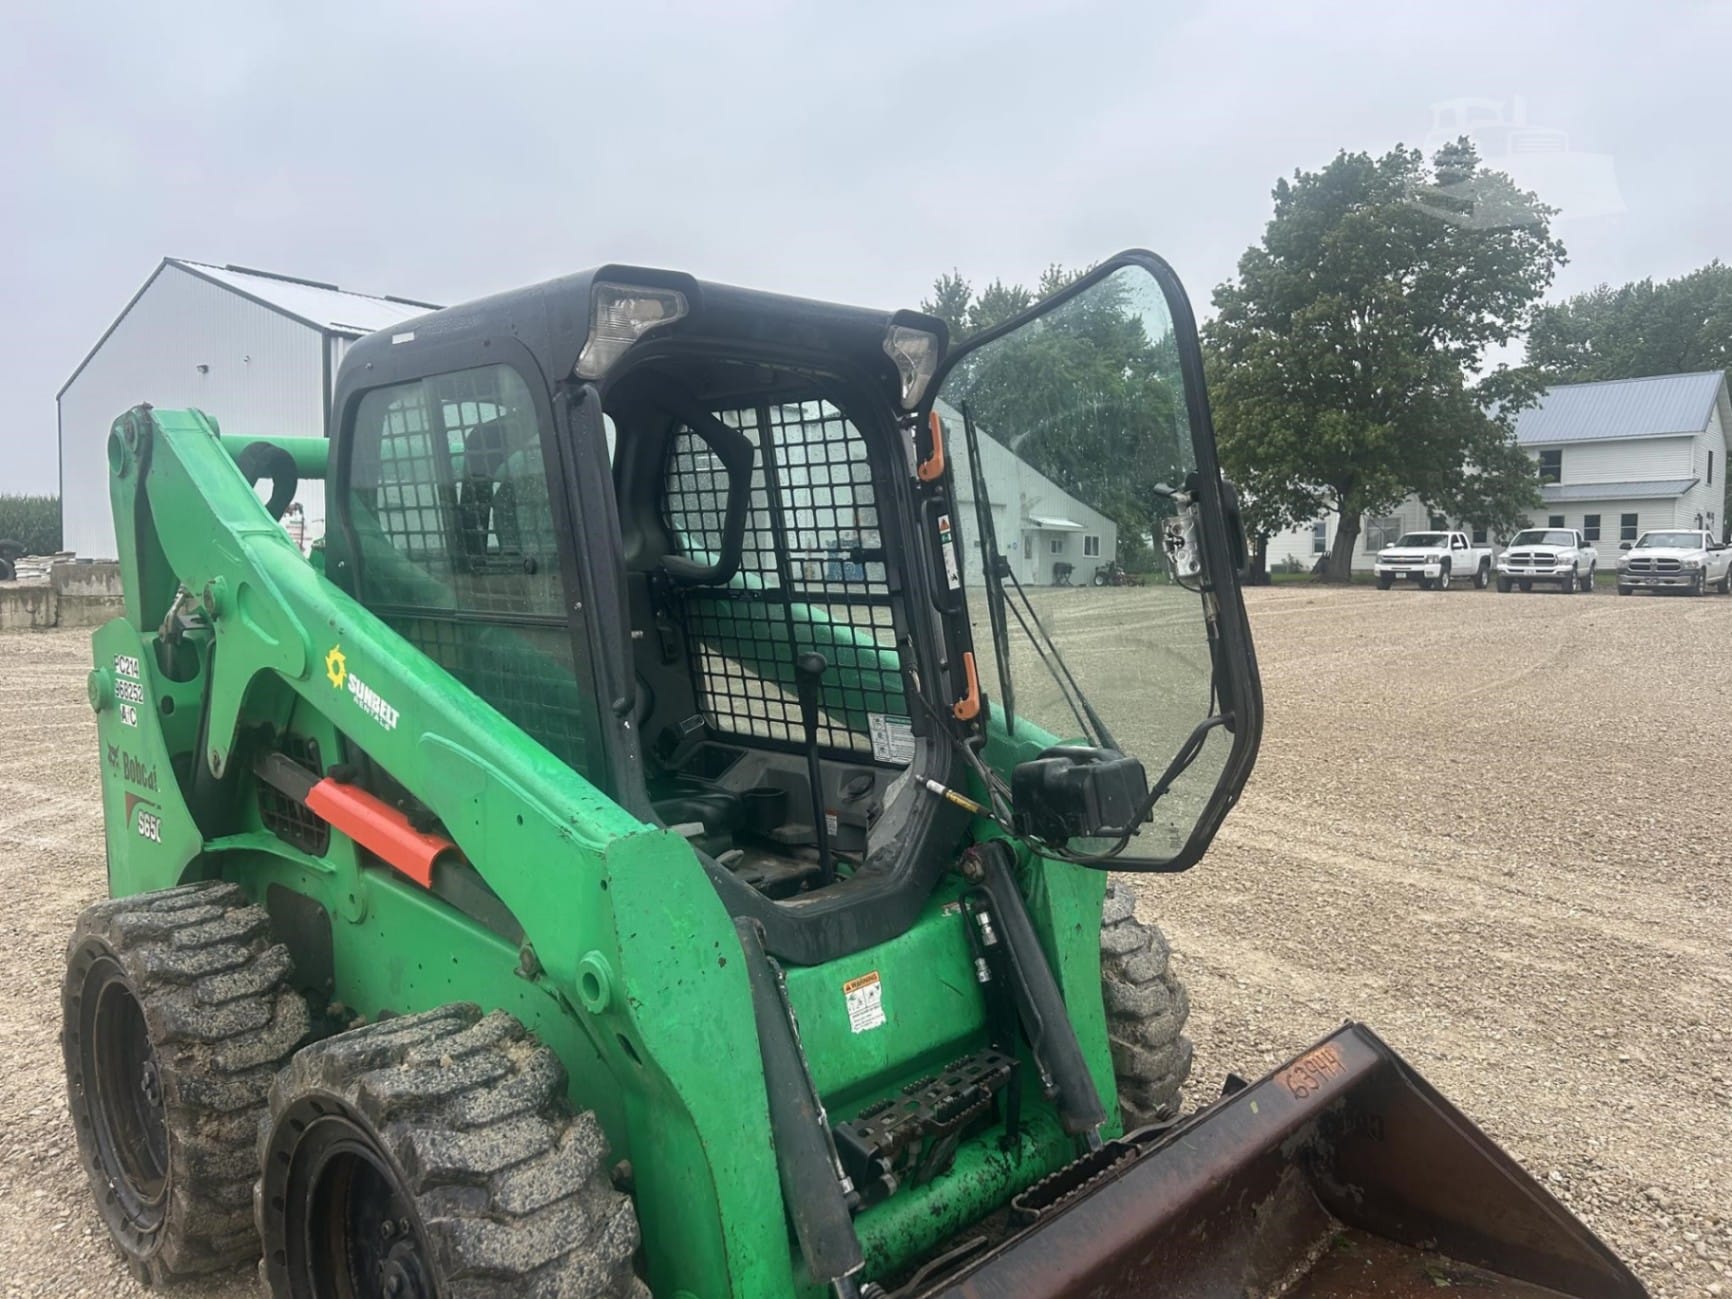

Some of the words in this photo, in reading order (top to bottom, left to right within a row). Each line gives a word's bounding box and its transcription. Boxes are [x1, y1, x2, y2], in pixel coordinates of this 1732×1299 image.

[347, 672, 400, 730] SUNBELT
[353, 695, 390, 732] RENTALS
[1286, 1049, 1347, 1100] 63944
